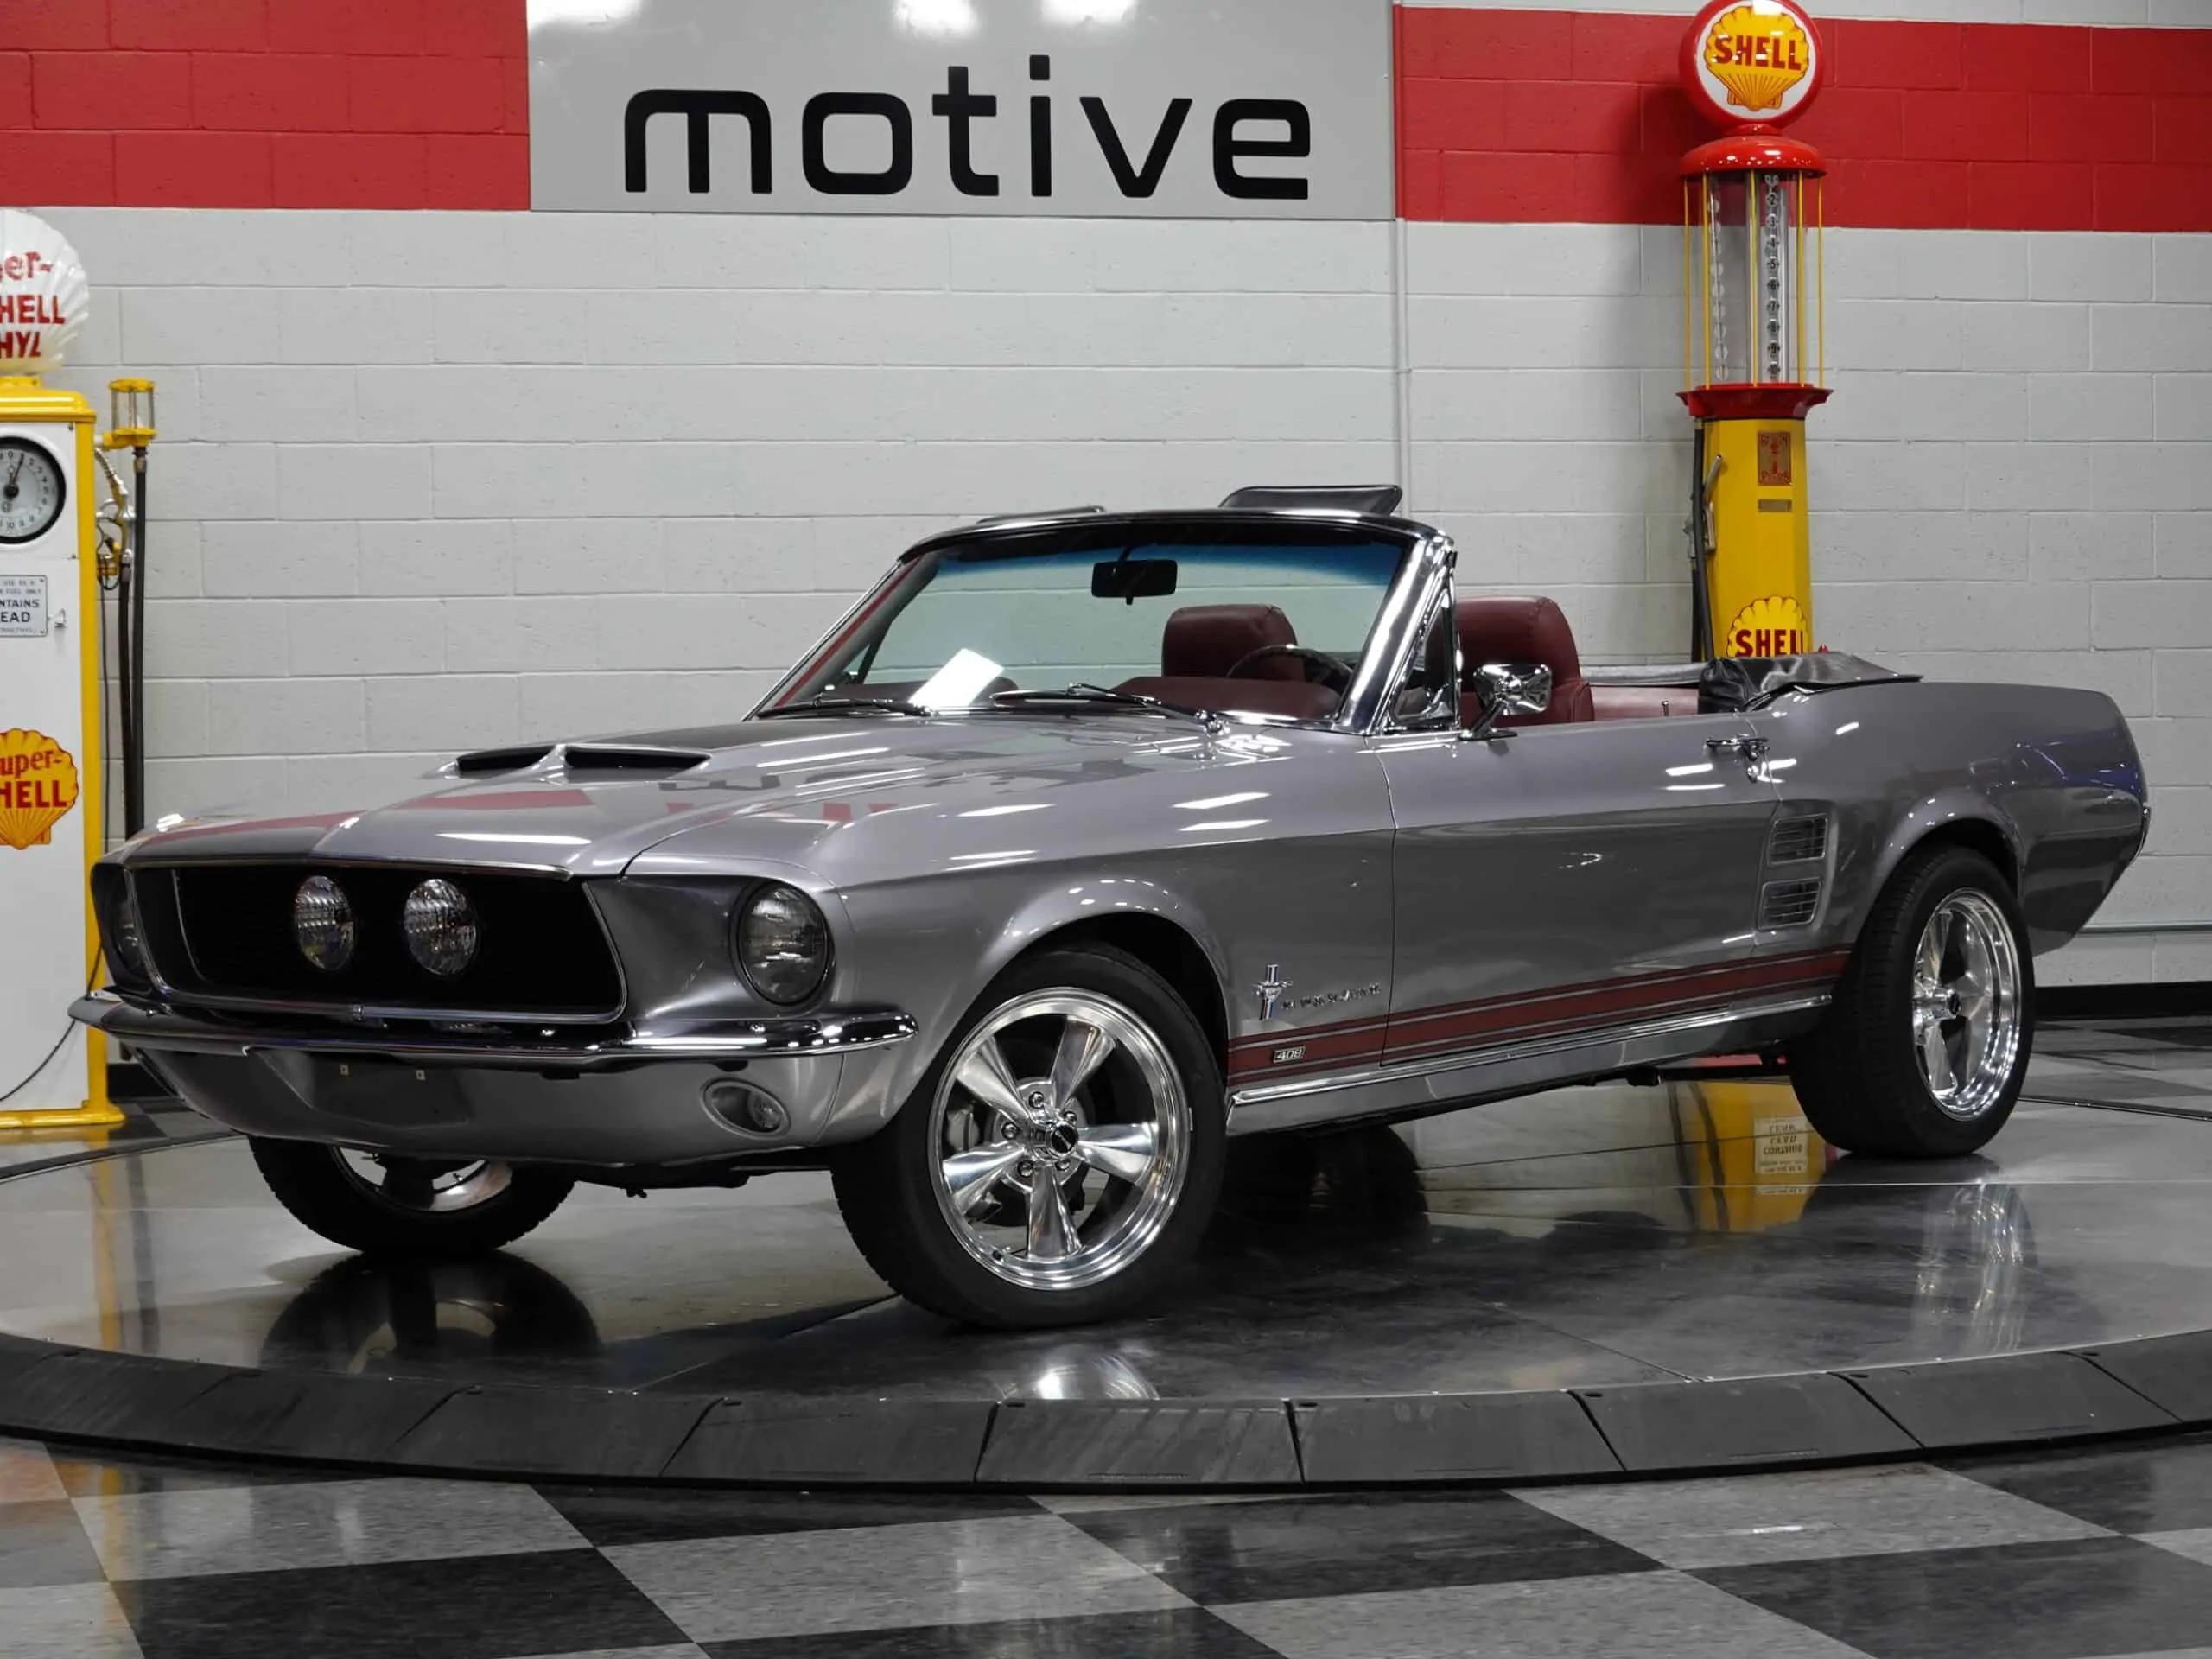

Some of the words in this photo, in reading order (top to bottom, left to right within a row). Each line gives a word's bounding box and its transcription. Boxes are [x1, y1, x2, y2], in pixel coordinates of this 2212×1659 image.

[1714, 35, 1802, 71] SHELL
[624, 54, 1311, 200] motive
[1770, 194, 1776, 205] 2
[1770, 216, 1776, 226] 3
[0, 251, 54, 283] er-
[1770, 259, 1776, 270] 5
[1770, 279, 1777, 290] 6
[1770, 301, 1776, 312] 7
